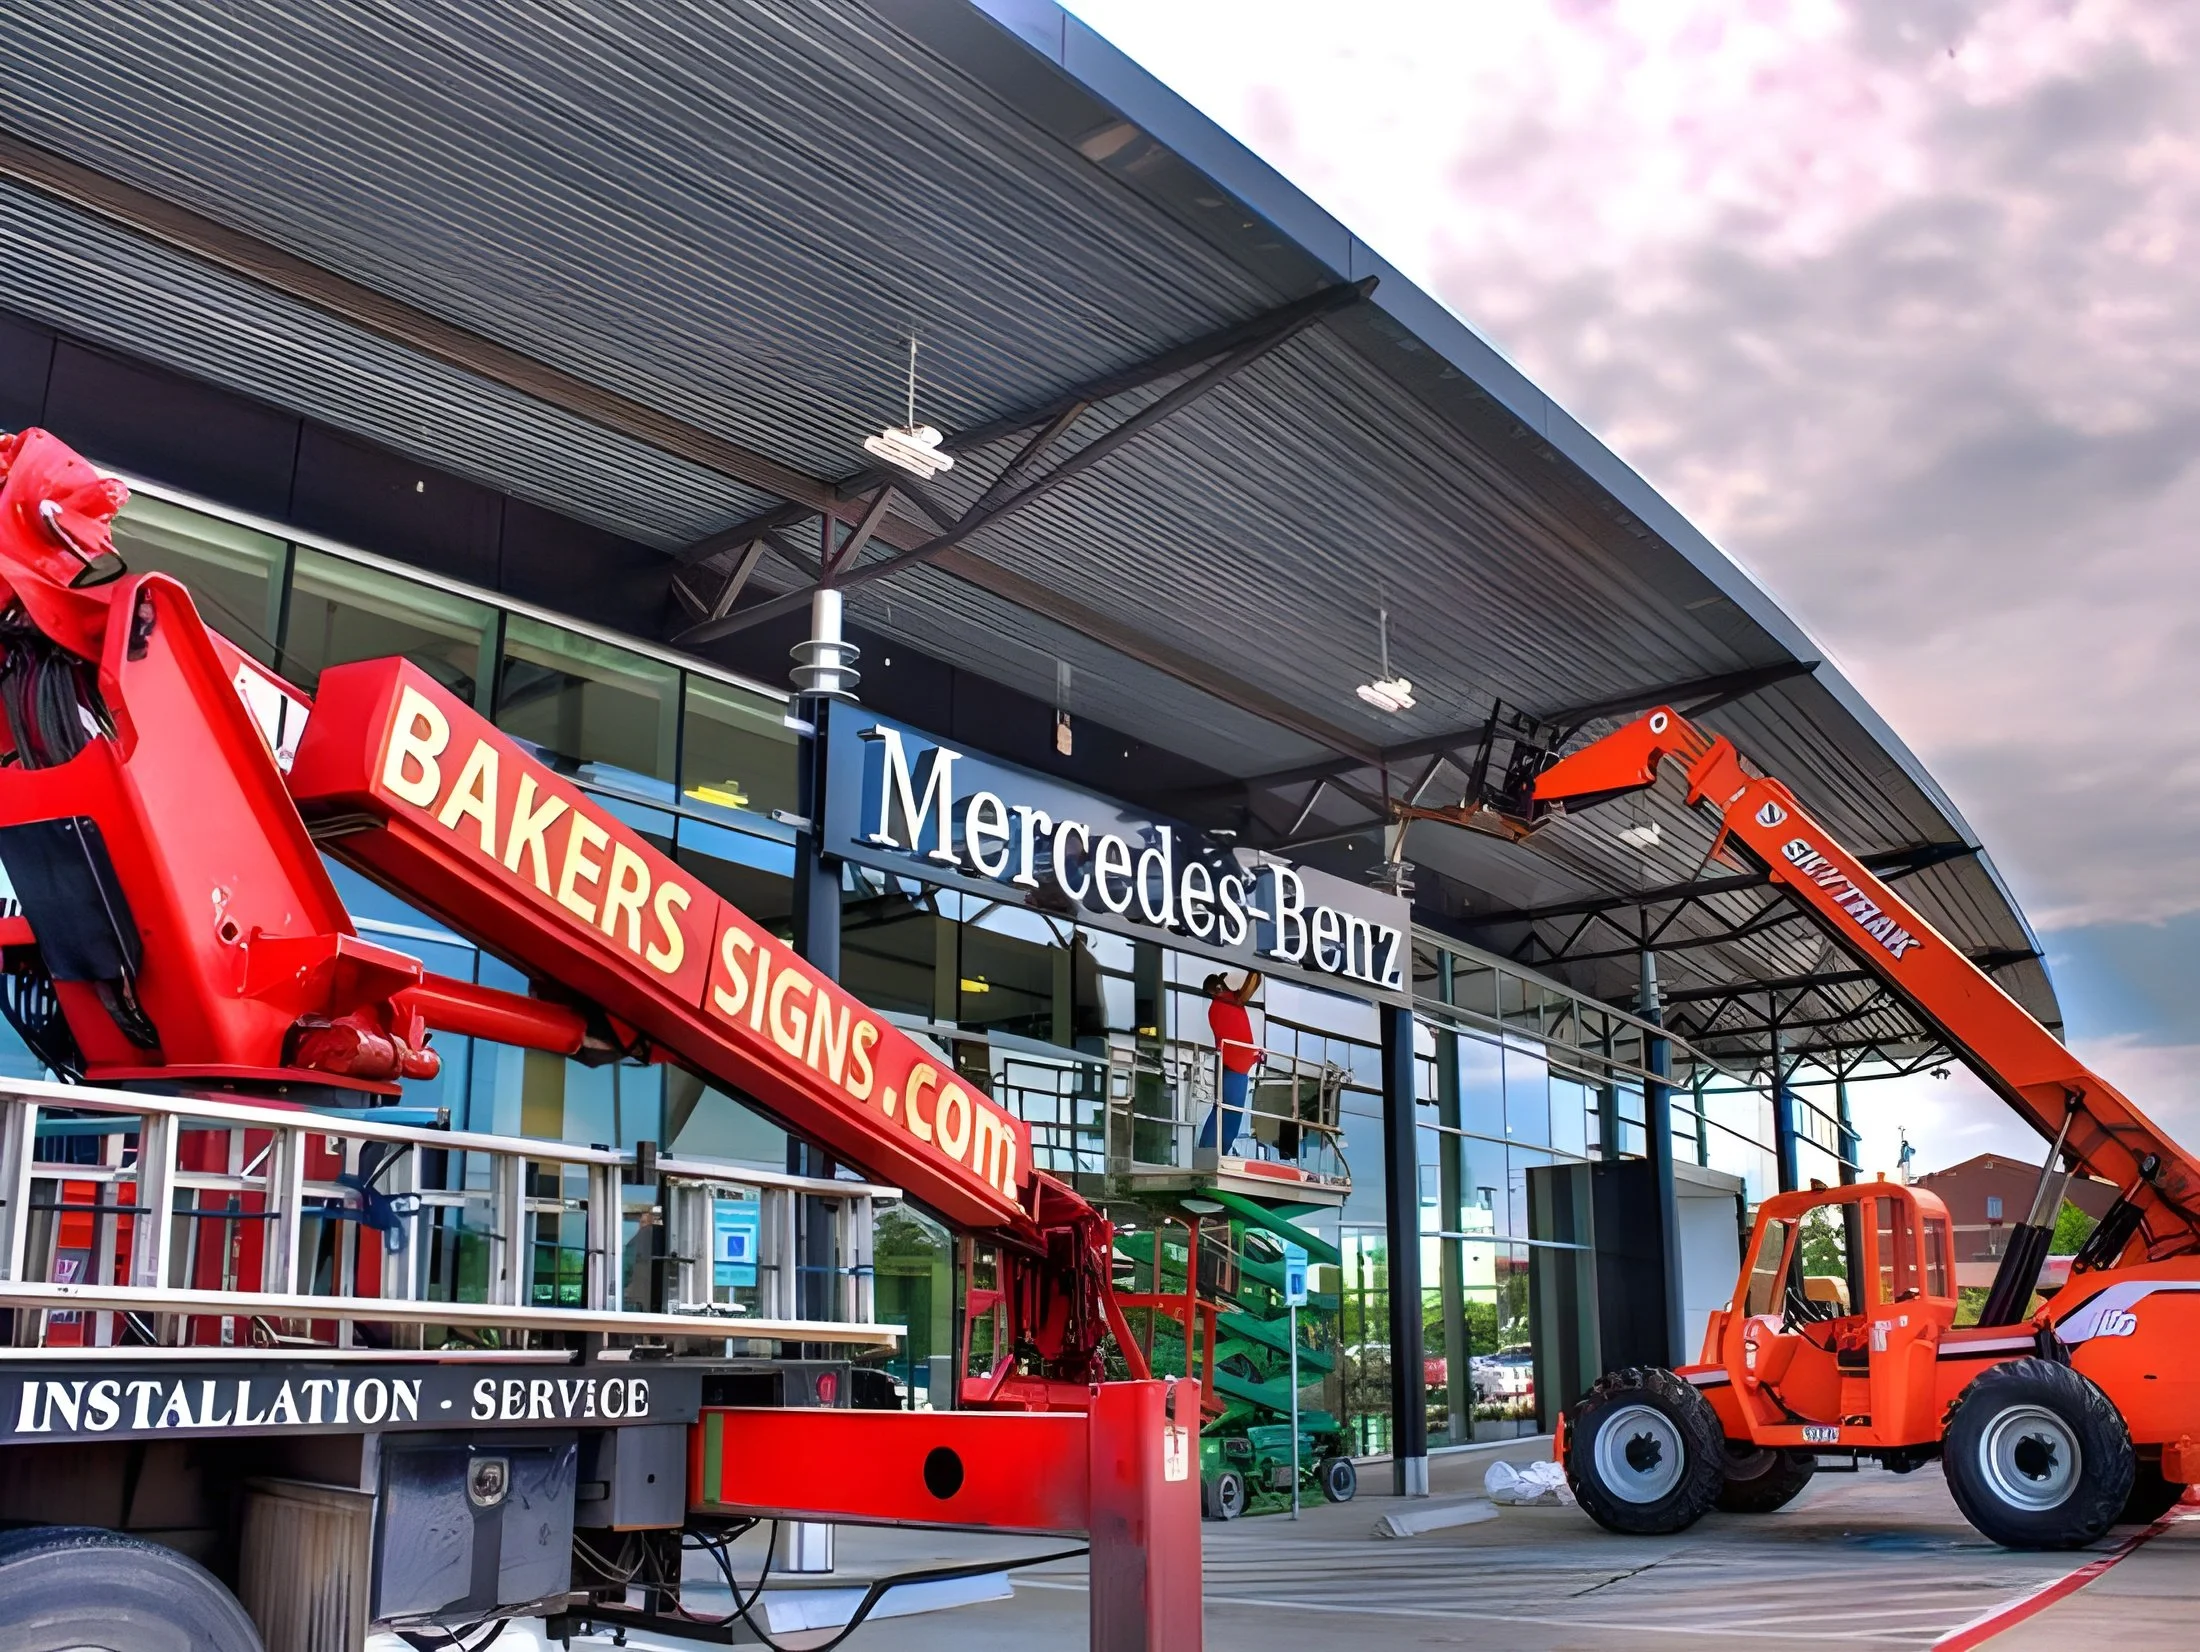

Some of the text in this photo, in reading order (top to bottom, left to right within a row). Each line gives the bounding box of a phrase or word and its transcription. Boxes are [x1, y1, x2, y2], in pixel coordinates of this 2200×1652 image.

[382, 684, 692, 974] BAKERS
[860, 724, 1404, 991] Mercedes-Benz
[14, 1377, 649, 1432] INSTALLATION SERVICE
